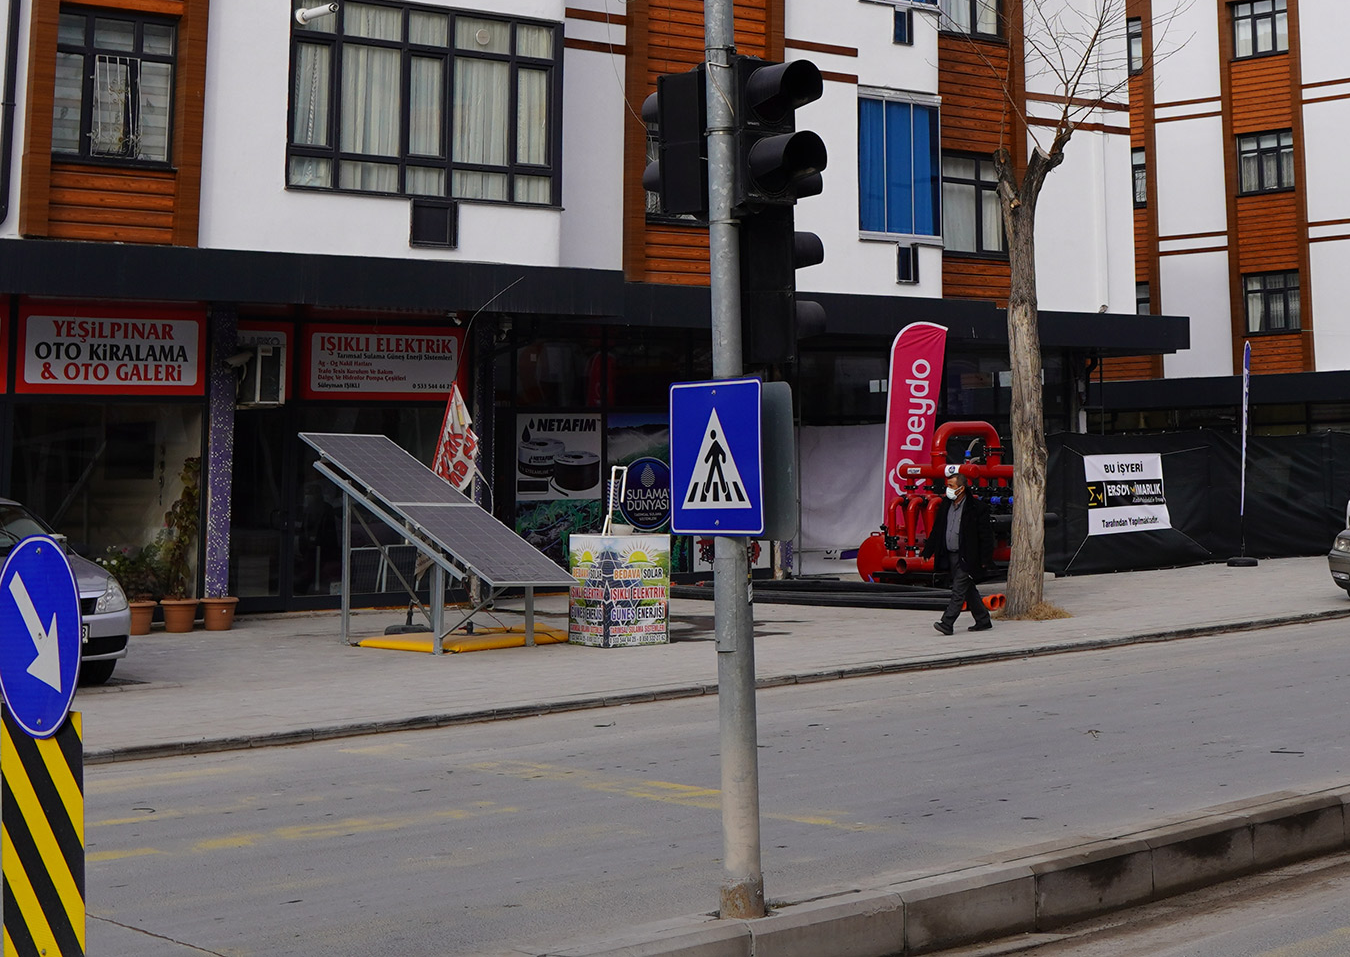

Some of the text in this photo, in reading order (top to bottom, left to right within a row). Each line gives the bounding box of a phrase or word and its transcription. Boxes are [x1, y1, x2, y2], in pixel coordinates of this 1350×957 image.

[35, 342, 81, 360] OTO
[320, 336, 370, 356] IŞIKLI
[40, 362, 58, 380] &
[64, 362, 109, 380] OTO
[901, 358, 936, 451] beydo
[536, 419, 596, 432] NETAFIM
[1104, 461, 1143, 476] BU İŞYERİ
[614, 568, 663, 579] BEDAVA SOLAR
